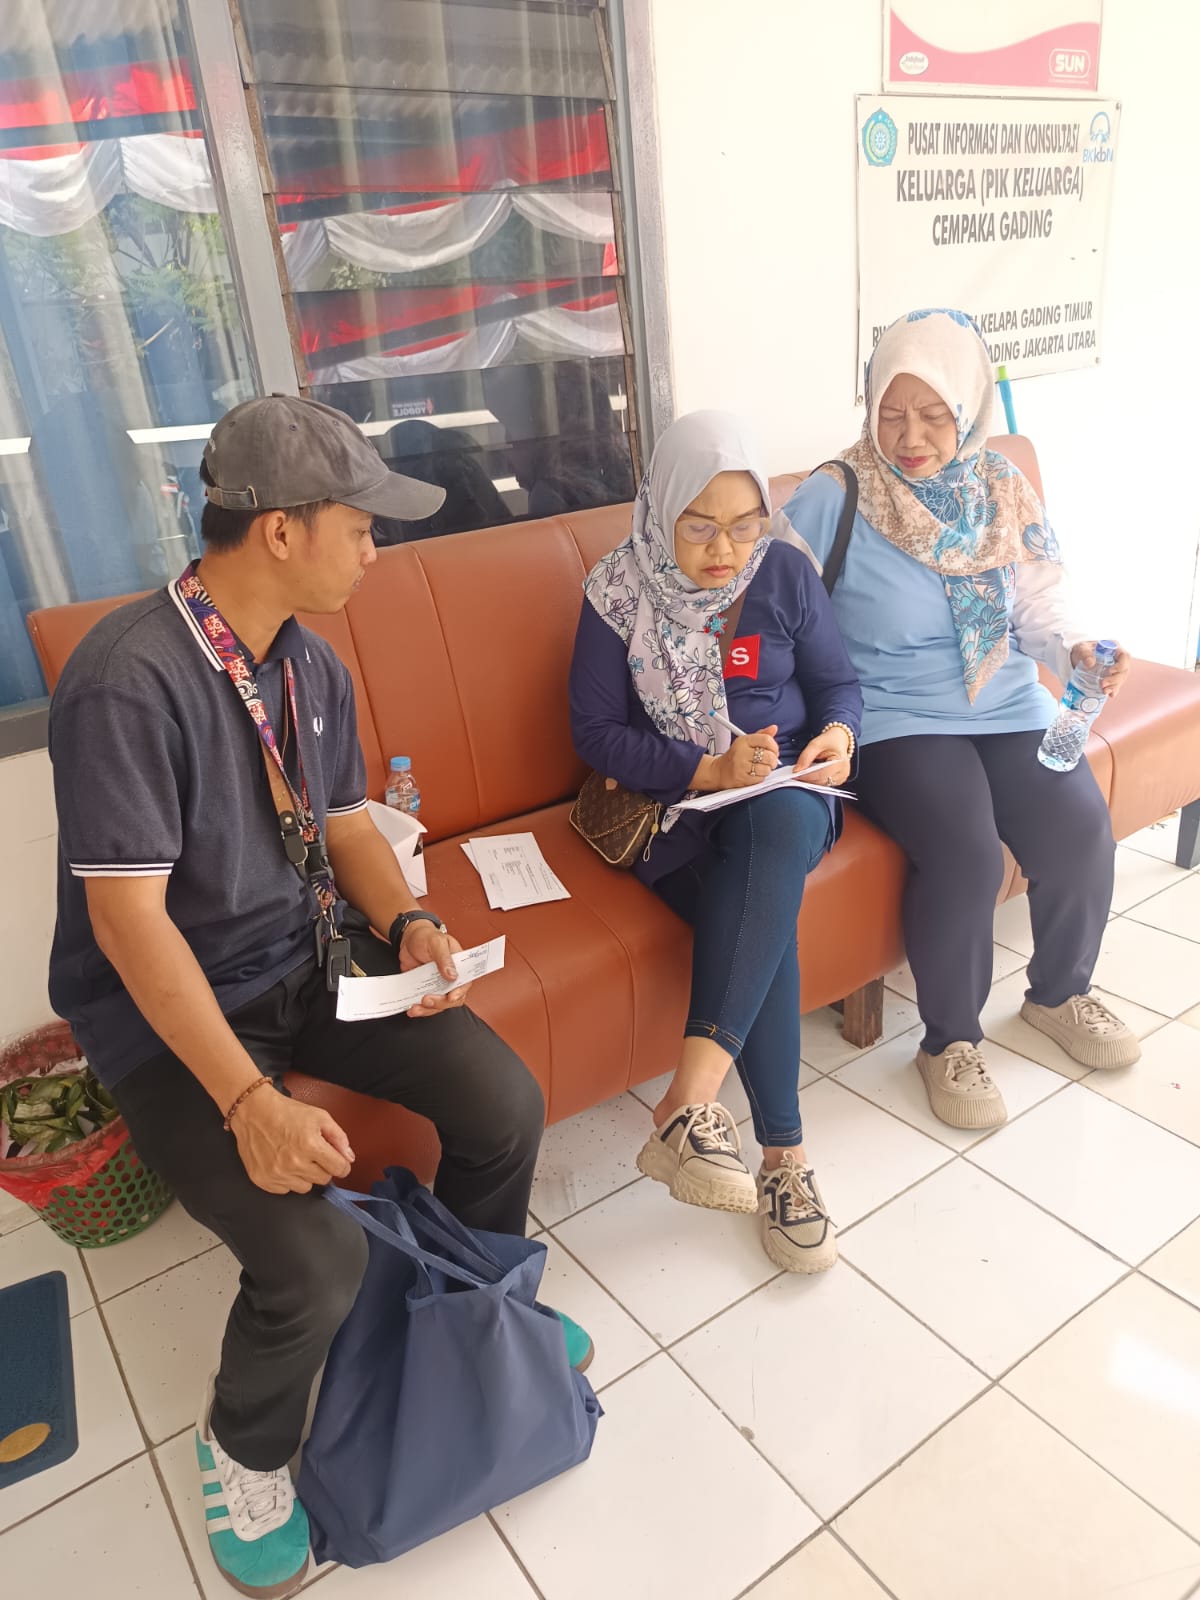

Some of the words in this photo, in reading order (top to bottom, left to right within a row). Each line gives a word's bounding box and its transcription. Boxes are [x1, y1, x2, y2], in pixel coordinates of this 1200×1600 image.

[1054, 53, 1085, 73] SUN
[908, 122, 941, 155] PUSAT
[943, 122, 999, 155] INFORMASI
[1001, 123, 1022, 154] DAN
[1024, 123, 1080, 153] KONSULTASI
[896, 168, 976, 202] KELUARGA
[981, 168, 1010, 206] (PIK
[1013, 165, 1084, 202] KELUARGA)
[932, 212, 996, 246] CEMPAKA
[1000, 209, 1053, 241] GADING
[980, 310, 1018, 333] KELAPA
[1021, 305, 1061, 329] GADING
[1064, 301, 1093, 323] TIMUR
[988, 340, 1020, 363] ADING
[1022, 334, 1064, 359] JAKARTA
[1067, 330, 1096, 351] UTARA
[208, 613, 227, 634] HOT
[233, 657, 250, 678] HOT
[731, 647, 750, 666] S
